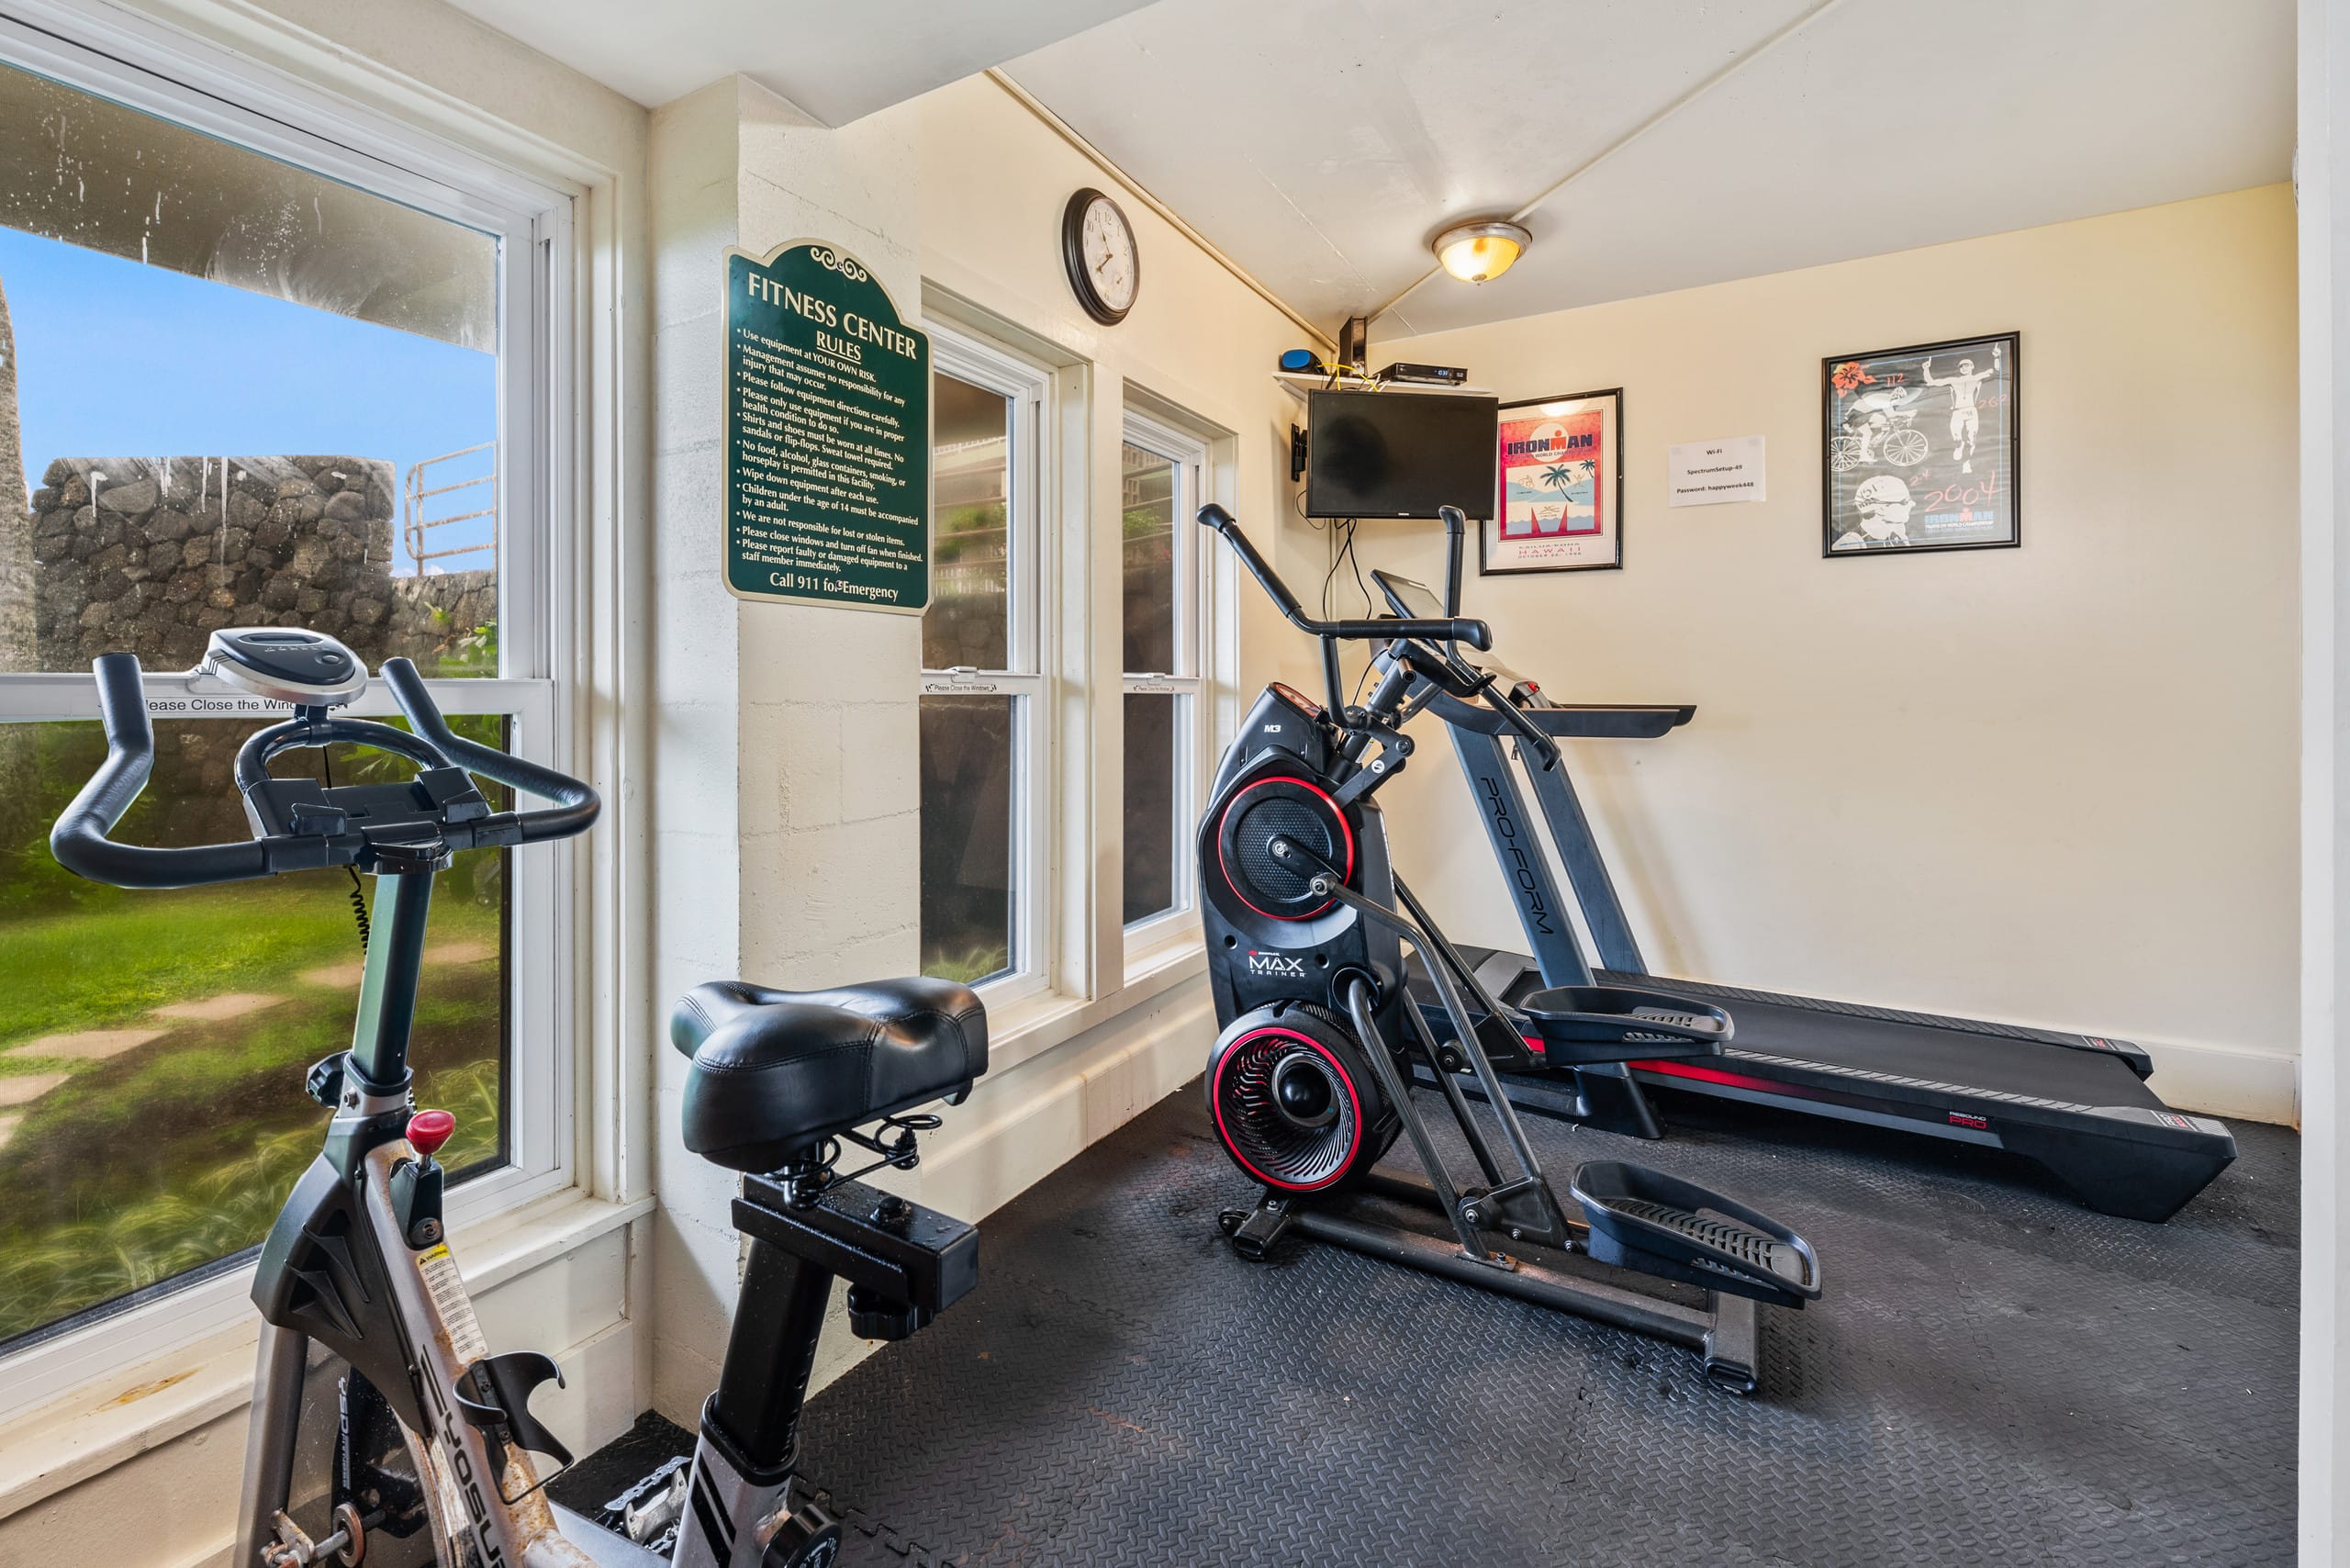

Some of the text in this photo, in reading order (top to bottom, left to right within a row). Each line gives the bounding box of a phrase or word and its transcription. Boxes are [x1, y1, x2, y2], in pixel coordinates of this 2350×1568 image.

[749, 272, 916, 360] FITNESS CENTER
[744, 328, 876, 383] Use equipment at YOUR OWN RISK.
[817, 330, 860, 362] RULES
[743, 354, 826, 391] injury that may occur.
[743, 343, 904, 408] Management assumes no responsibility for any
[743, 371, 900, 429] Please follow equipment directions carefully.
[743, 386, 904, 442] Please only use equipment if you are in proper
[743, 398, 838, 434] health condition to do so.
[743, 411, 903, 464] Shirts and shoes must be worn at all times. No
[743, 425, 892, 471] sandals or flip-flops. Sweat towel required.
[1507, 431, 1593, 455] IRONMAN
[743, 439, 755, 451] No
[757, 442, 778, 459] food,
[780, 448, 810, 465] alcohol,
[812, 456, 829, 473] glass
[831, 463, 867, 482] containers,
[869, 472, 897, 487] smoking,
[743, 450, 875, 492] horseplay is permitted in this facility.
[743, 466, 878, 505] Wipe down equipment after each use.
[743, 493, 789, 512] by an adult.
[1676, 486, 1707, 494] Password:
[1923, 469, 2003, 512] 2004
[743, 482, 918, 526] Children under the age of 14 must be accompanied
[1924, 509, 1994, 524] IRONMAN
[743, 510, 904, 546] We are not responsible for lost or stolen items.
[743, 525, 923, 562] Please close windows and turn off fan when finished.
[742, 551, 841, 574] staff member immediately.
[743, 538, 767, 551] Please
[769, 544, 793, 558] report
[796, 545, 816, 560] faulty
[828, 550, 858, 566] damaged
[860, 556, 894, 569] equipment
[896, 561, 902, 570] to
[1518, 546, 1581, 554] HAWAII
[769, 572, 793, 588] Call
[798, 576, 818, 590] 911
[843, 580, 898, 602] Emergency
[147, 699, 186, 711] lease
[191, 699, 233, 711] Close
[238, 700, 259, 711] the
[1264, 724, 1281, 734] M3
[1481, 778, 1554, 935] PRO-FORM
[1248, 956, 1304, 972] MAX
[1250, 969, 1305, 978] TRAINER
[1949, 1111, 1986, 1121] REBOUND
[1949, 1115, 1986, 1129] PRO
